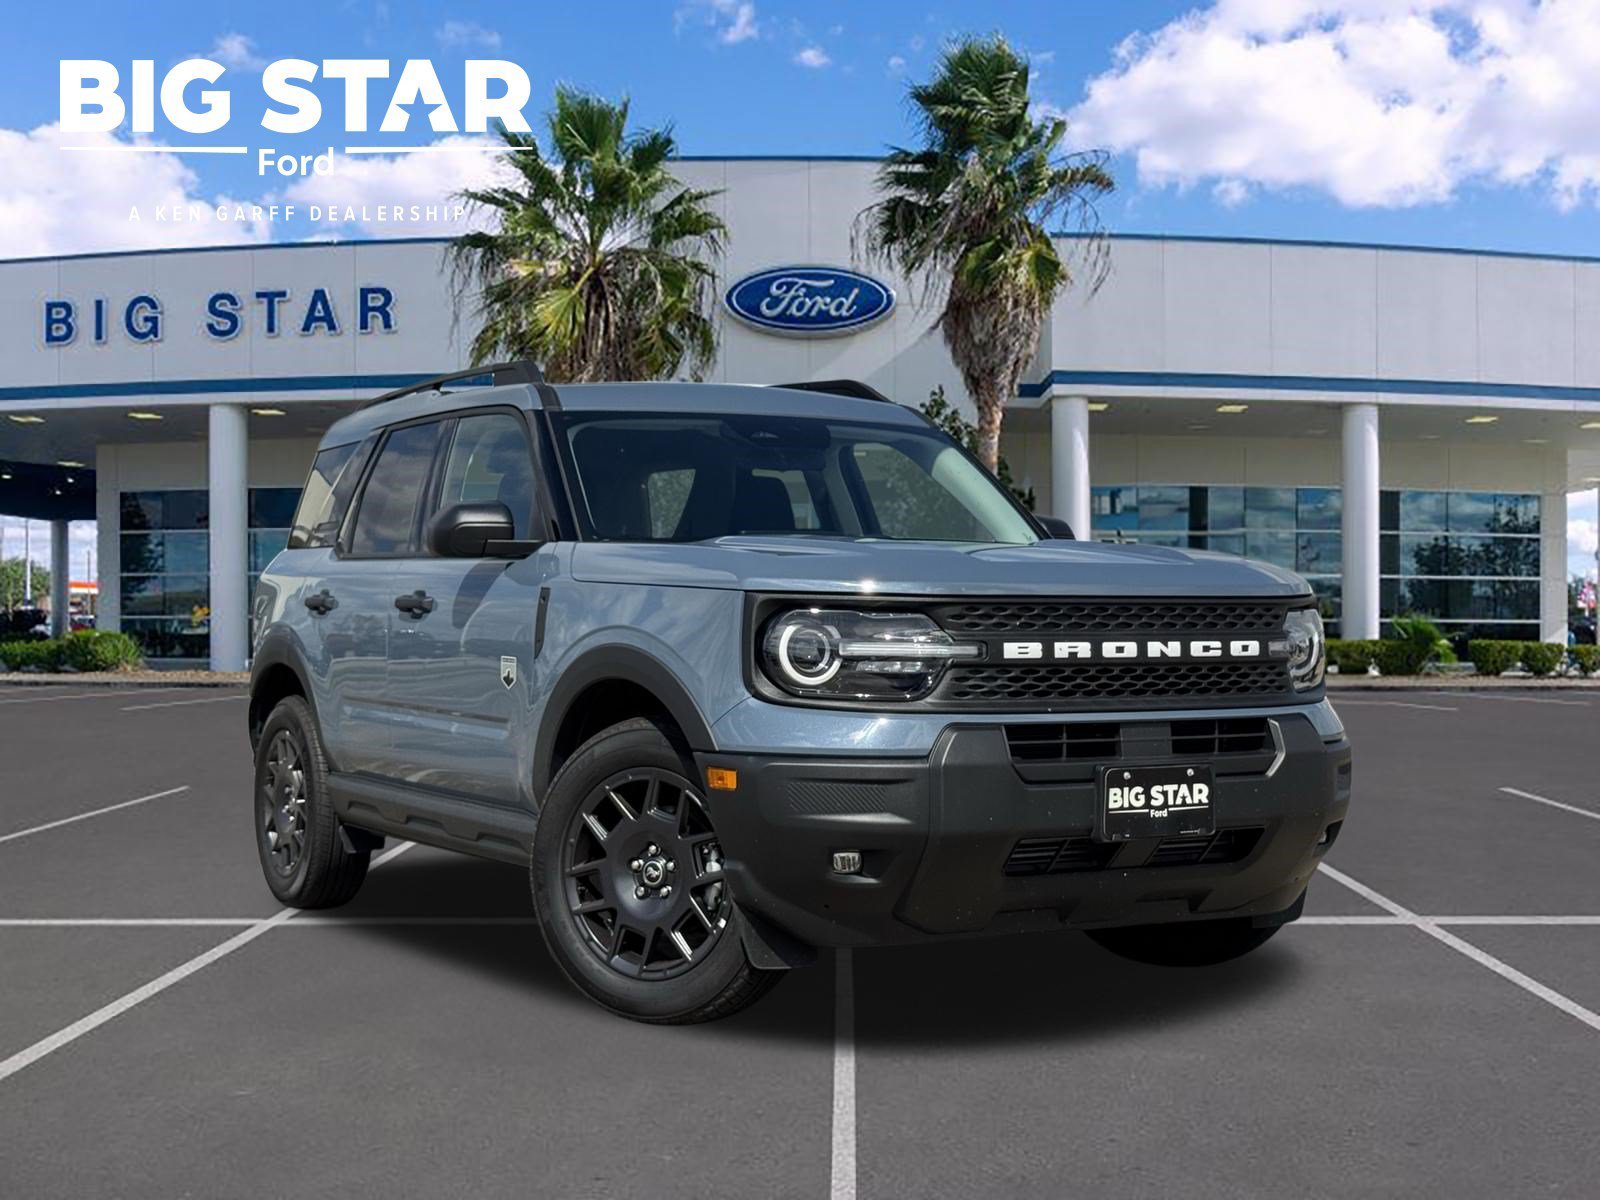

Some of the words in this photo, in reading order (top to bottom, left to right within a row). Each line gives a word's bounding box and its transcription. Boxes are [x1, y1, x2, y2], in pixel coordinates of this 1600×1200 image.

[759, 277, 860, 317] Ford
[45, 295, 163, 344] BIG
[206, 286, 397, 339] STAR
[1003, 640, 1260, 659] BRONCO
[1108, 785, 1146, 809] BIG
[1150, 783, 1209, 807] STAR
[1150, 808, 1168, 818] Ford
